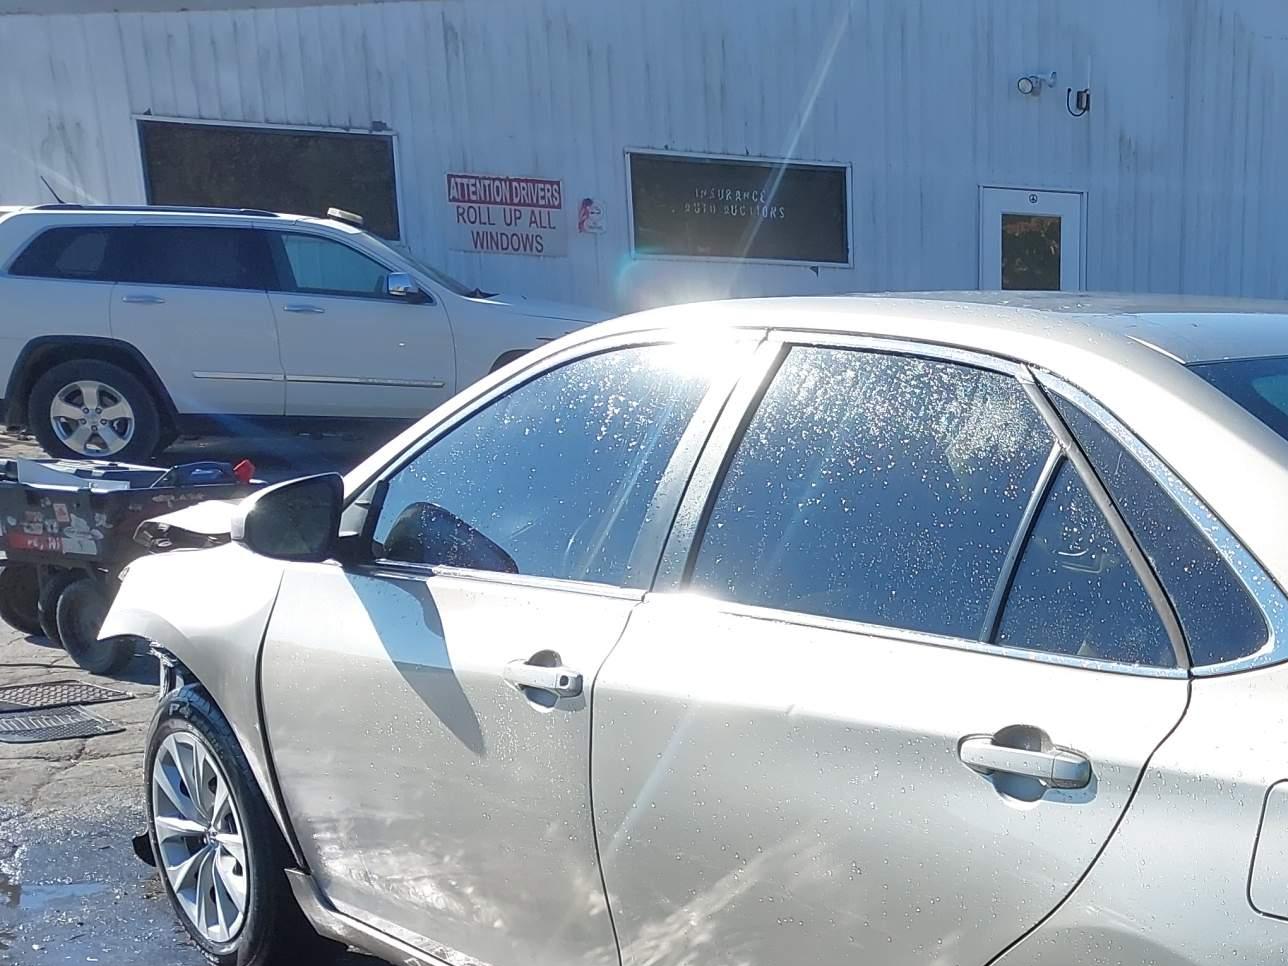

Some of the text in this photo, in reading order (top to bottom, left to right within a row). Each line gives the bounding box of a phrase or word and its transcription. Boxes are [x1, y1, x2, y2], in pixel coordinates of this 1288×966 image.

[449, 177, 560, 207] ATTENTION DRIVERS
[456, 204, 557, 230] ROLL UP ALL
[471, 230, 545, 254] WINDOWS
